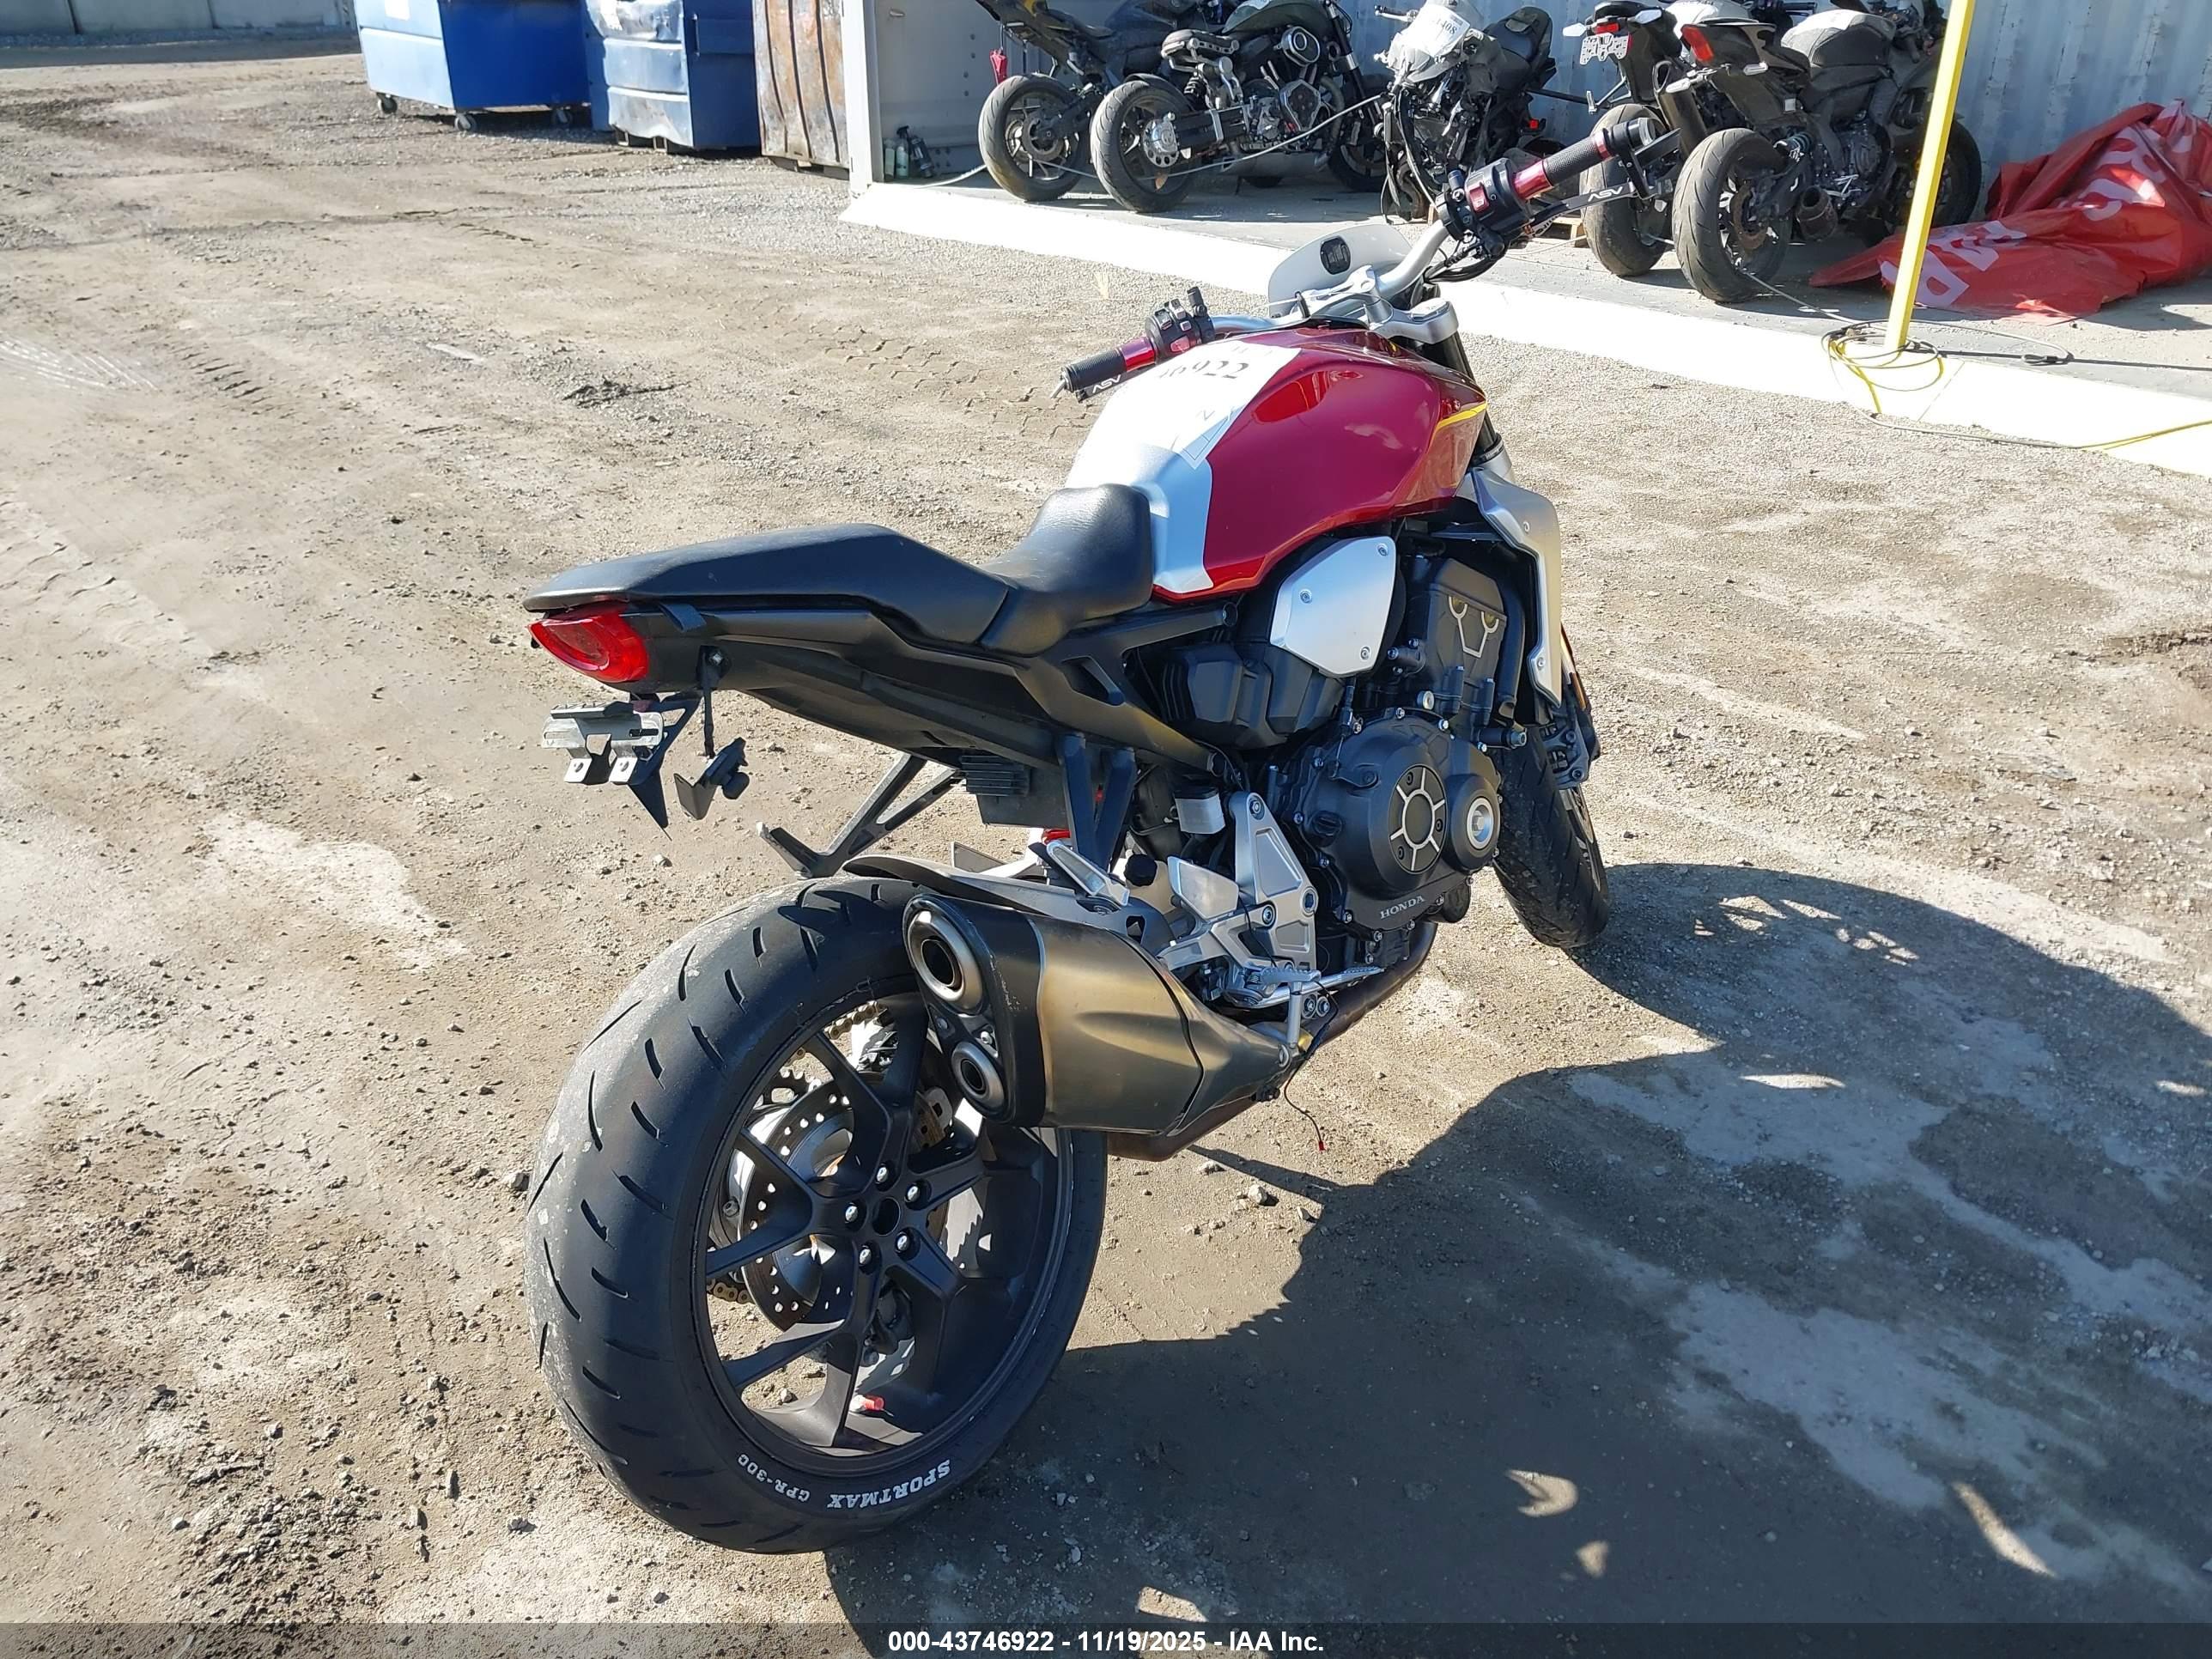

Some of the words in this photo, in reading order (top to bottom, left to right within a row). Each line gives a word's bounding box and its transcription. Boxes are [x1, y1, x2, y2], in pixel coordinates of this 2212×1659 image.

[1092, 374, 1121, 394] ASV
[1380, 895, 1425, 920] HONDA
[827, 1459, 951, 1510] SPORTMAX
